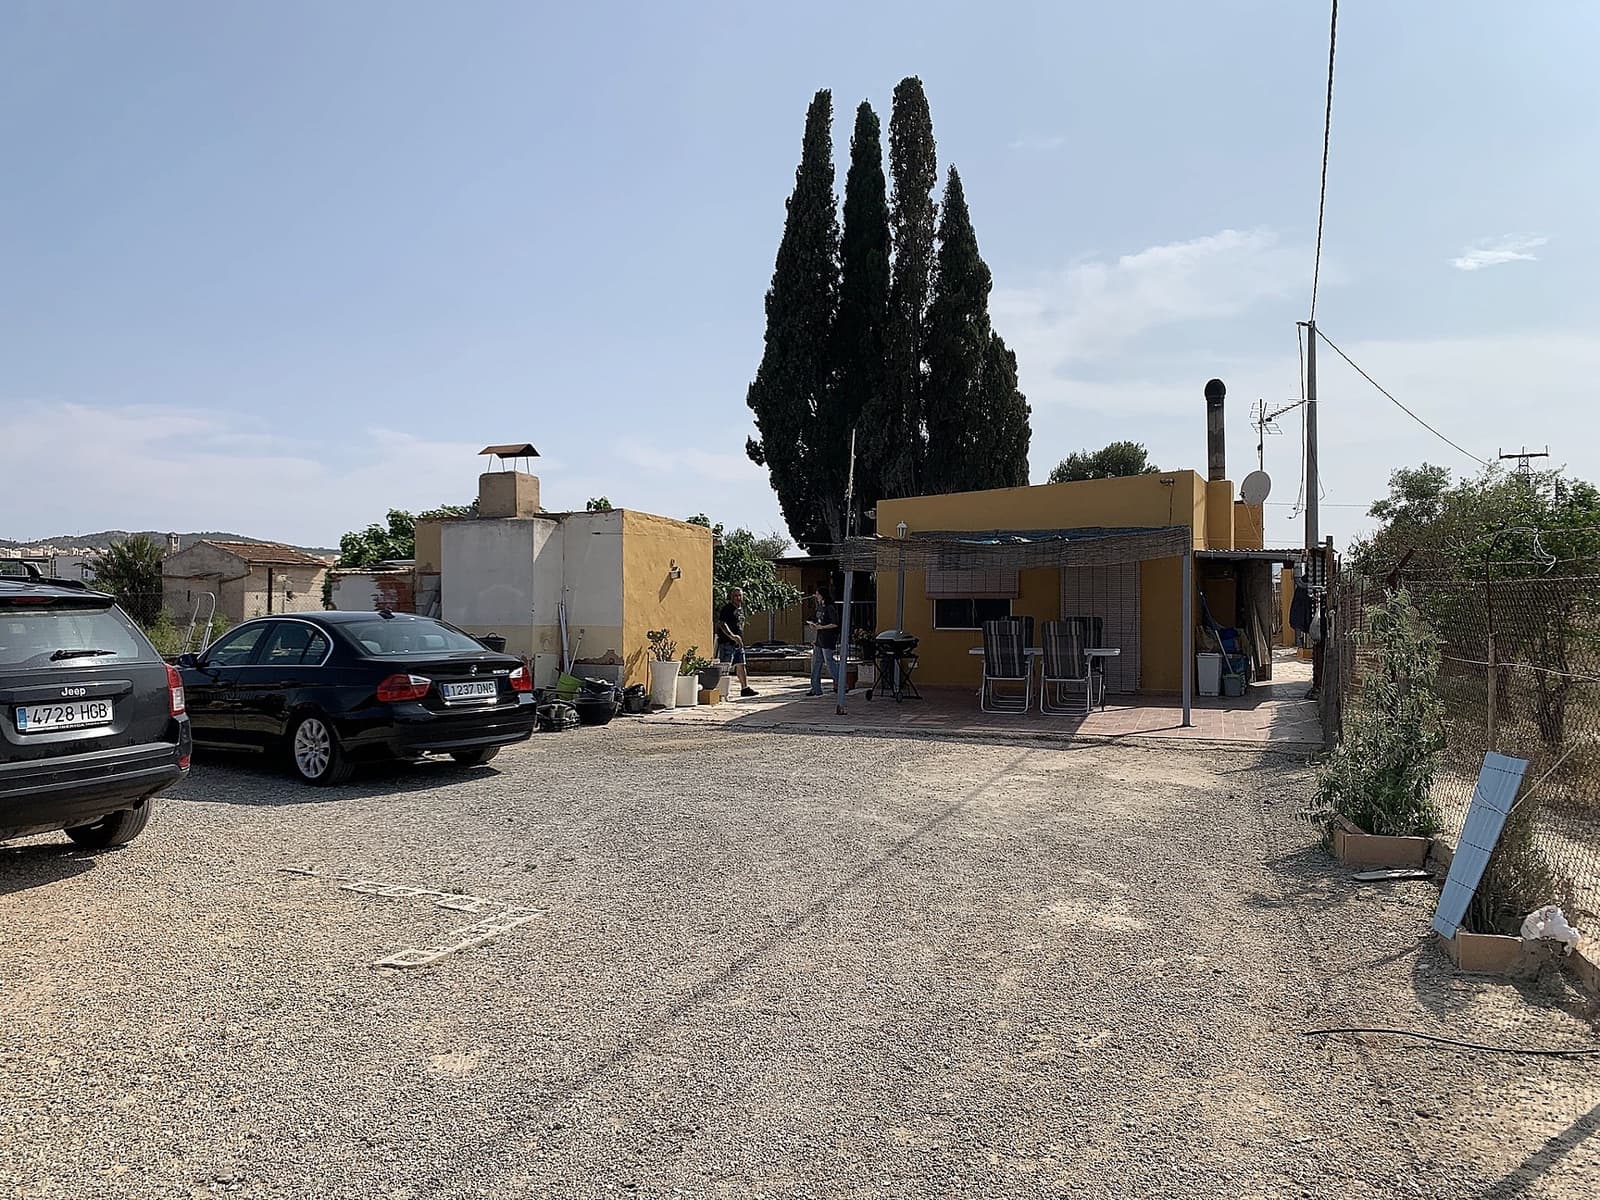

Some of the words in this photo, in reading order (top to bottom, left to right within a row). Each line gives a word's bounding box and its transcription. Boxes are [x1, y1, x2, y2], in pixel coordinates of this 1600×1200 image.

[61, 688, 86, 697] Jeep
[451, 684, 474, 696] 1237
[32, 706, 75, 725] 4728
[80, 703, 108, 720] HGB
